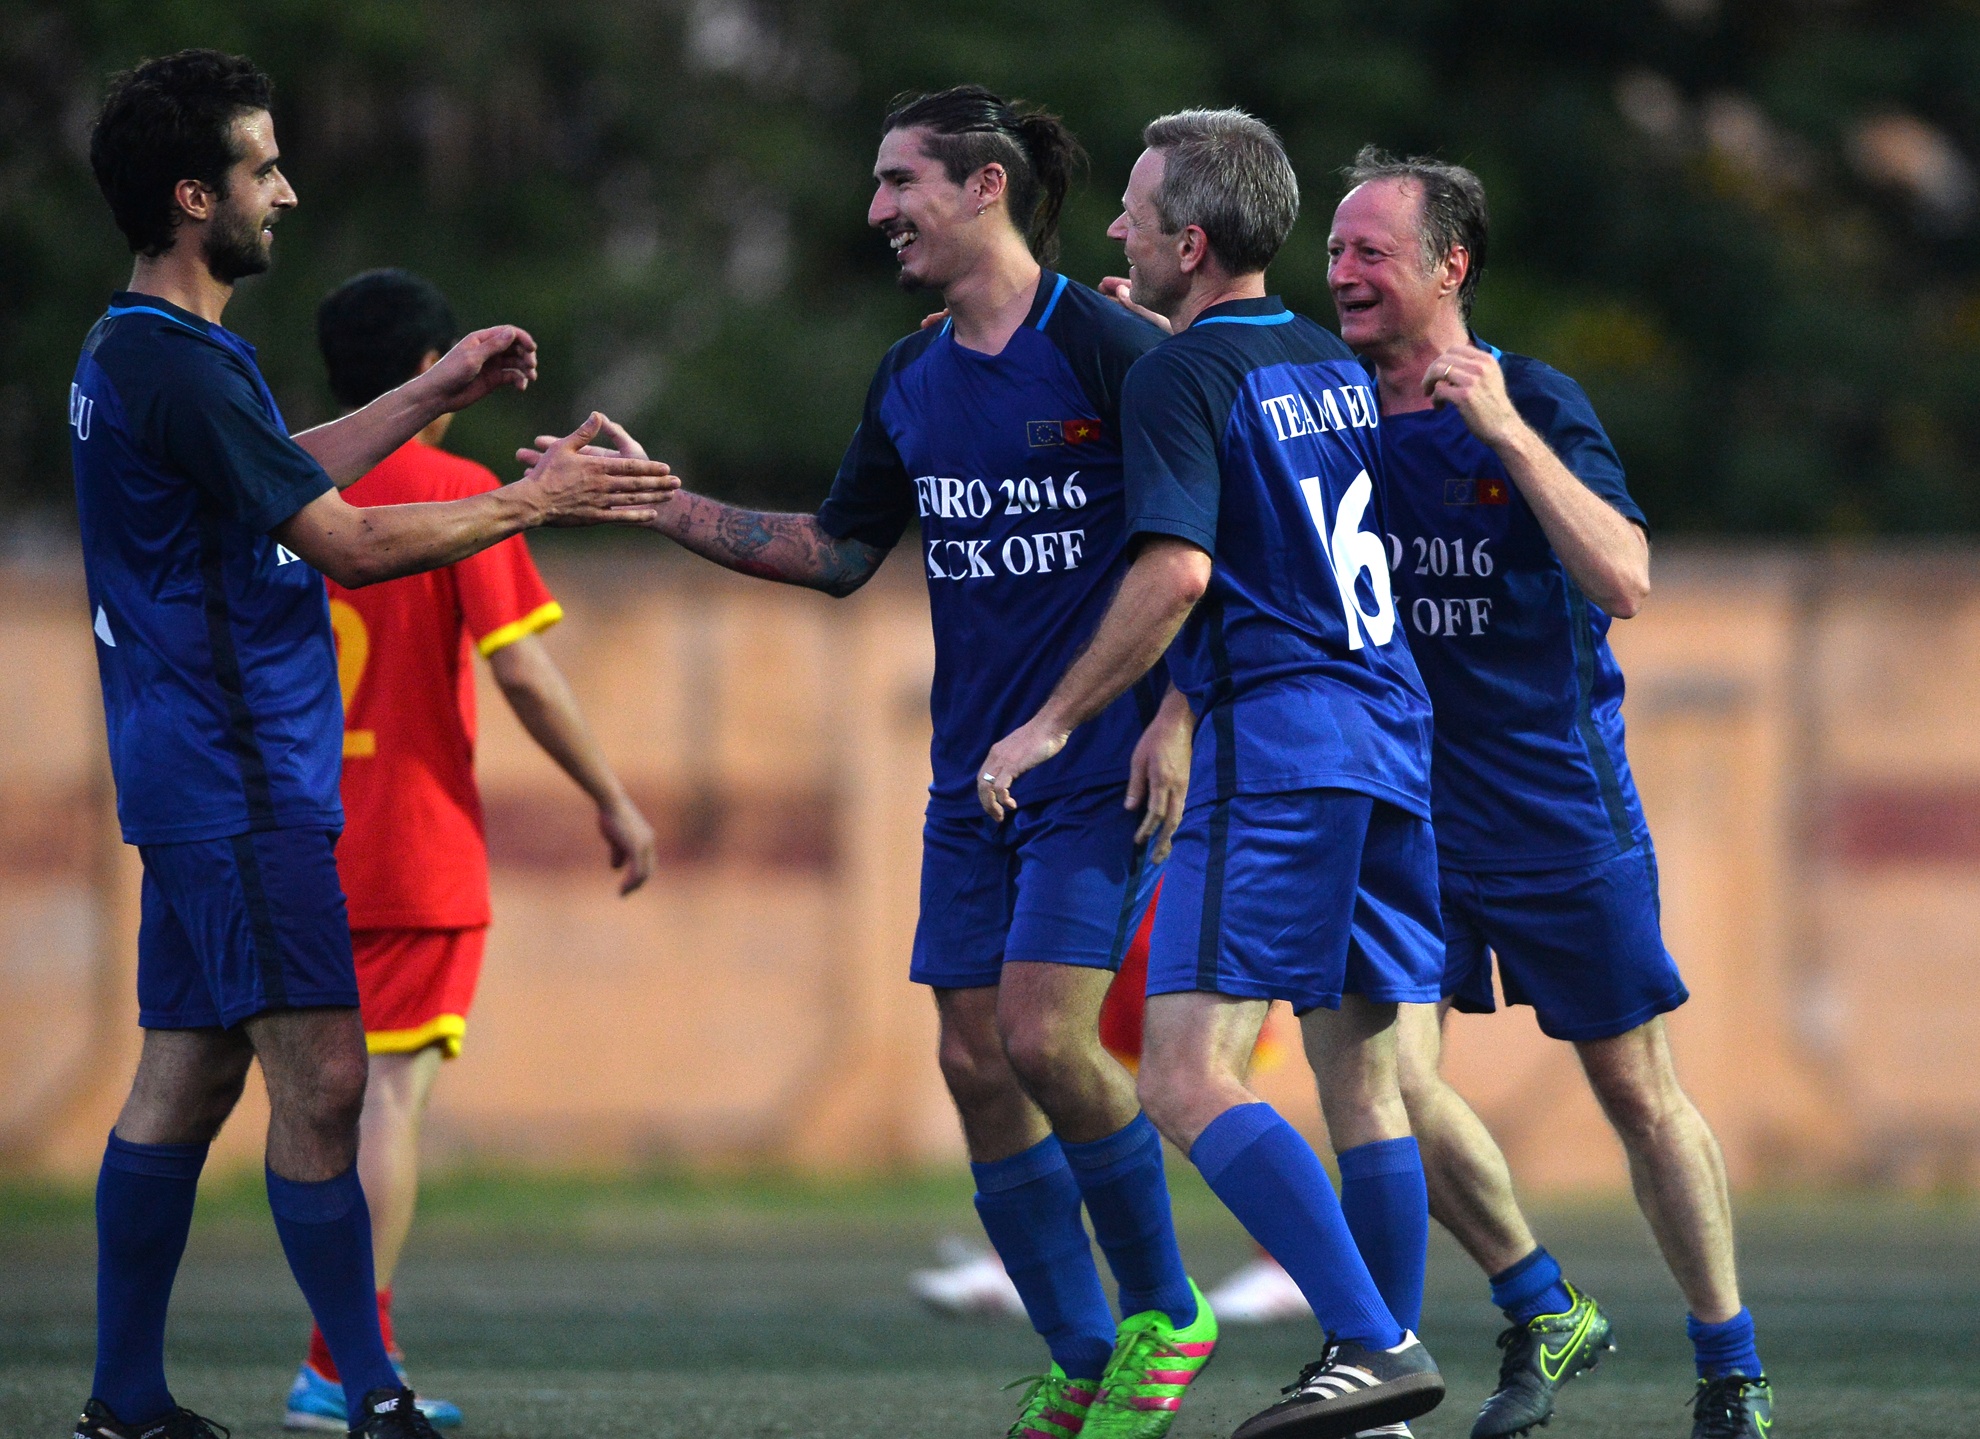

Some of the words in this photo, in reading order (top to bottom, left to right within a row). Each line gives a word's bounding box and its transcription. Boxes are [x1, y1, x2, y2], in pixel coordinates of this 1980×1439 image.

[1261, 389, 1347, 441] TEAM
[1339, 385, 1378, 429] EU
[999, 471, 1087, 515] 2016
[928, 539, 995, 580] KCK
[1002, 529, 1085, 575] OFF
[1299, 468, 1396, 650] 16
[1412, 536, 1493, 576] 2016
[1412, 598, 1492, 636] OFF
